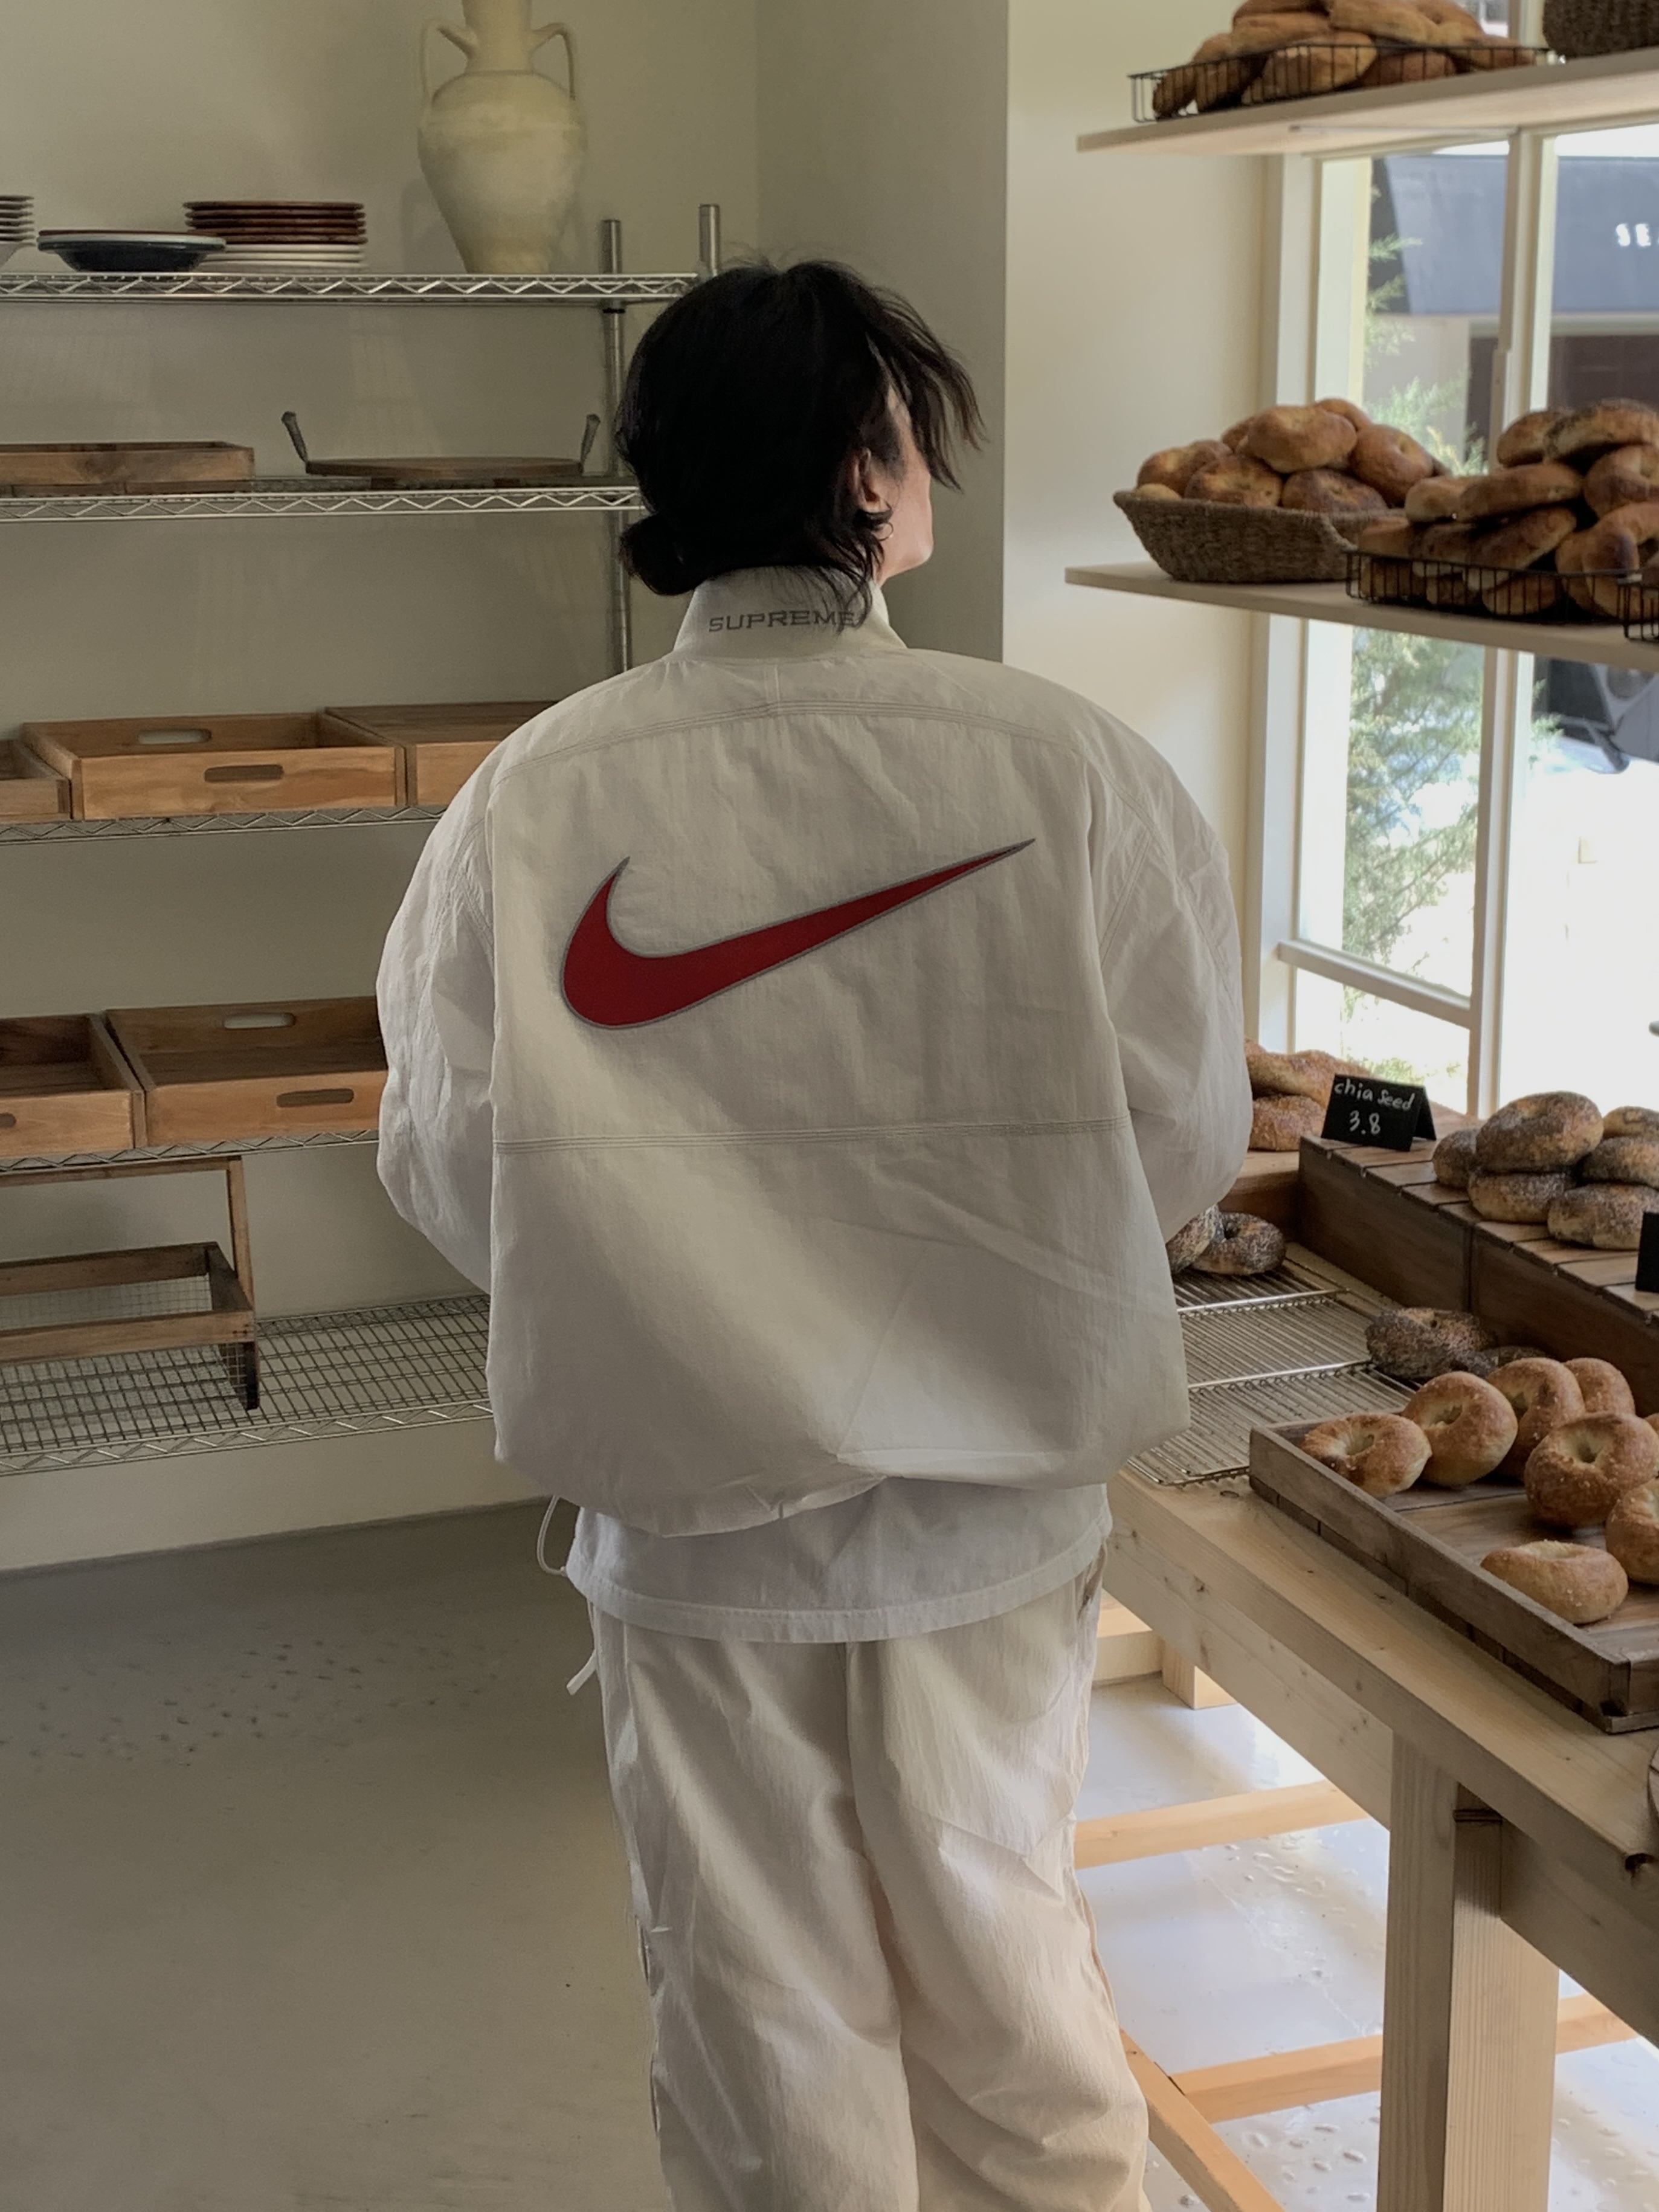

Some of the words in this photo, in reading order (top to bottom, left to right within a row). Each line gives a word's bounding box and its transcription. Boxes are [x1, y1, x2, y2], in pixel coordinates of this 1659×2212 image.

[1616, 223, 1659, 247] SE
[709, 610, 855, 633] SUPREME
[1334, 1079, 1373, 1101] chia
[1377, 1089, 1415, 1111] seed
[1349, 1109, 1381, 1135] 3.8
